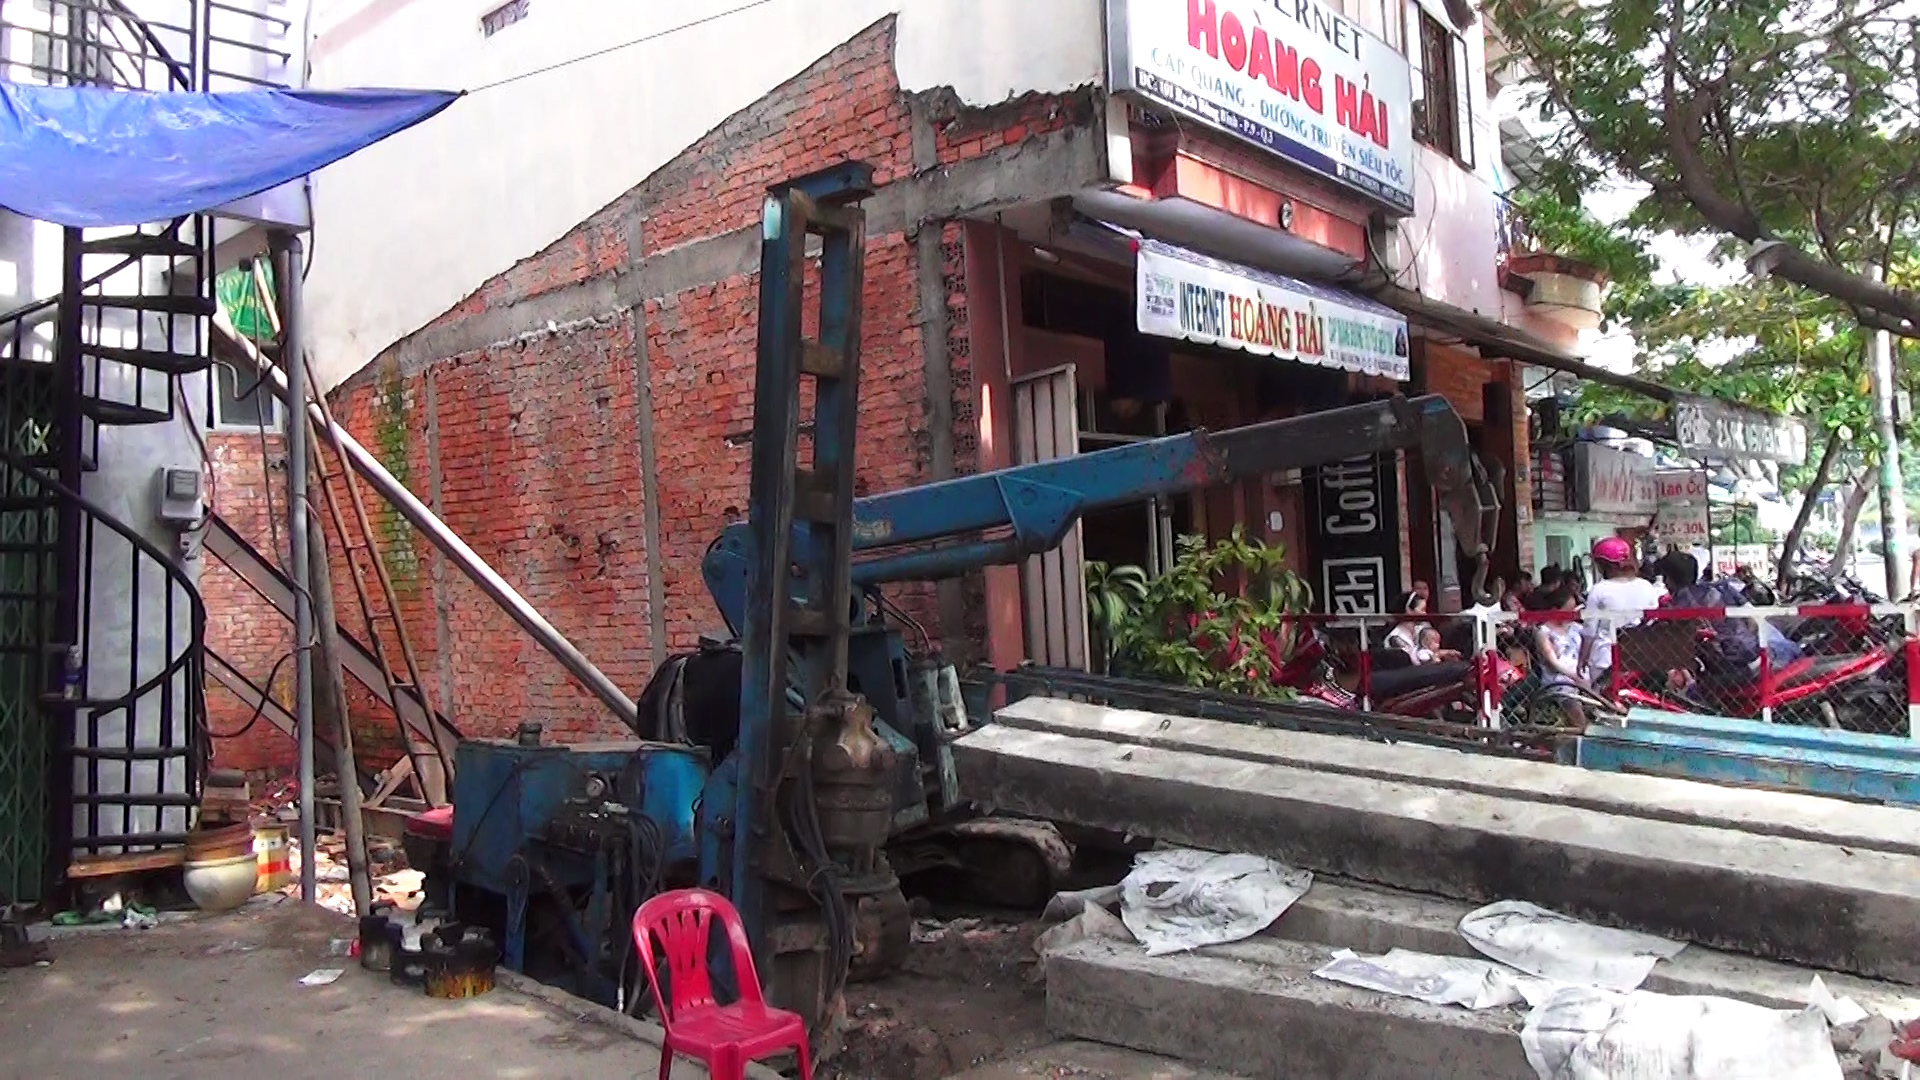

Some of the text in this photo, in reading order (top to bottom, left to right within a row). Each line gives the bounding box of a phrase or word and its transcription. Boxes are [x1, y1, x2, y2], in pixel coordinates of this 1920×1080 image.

[1187, 0, 1390, 150] HOÀNG HẢI
[1191, 65, 1245, 108] QUANG
[1179, 281, 1225, 338] INTERNET
[1228, 287, 1292, 351] HOÀNG
[1294, 299, 1325, 356] HẢI
[1322, 454, 1377, 535] Coff
